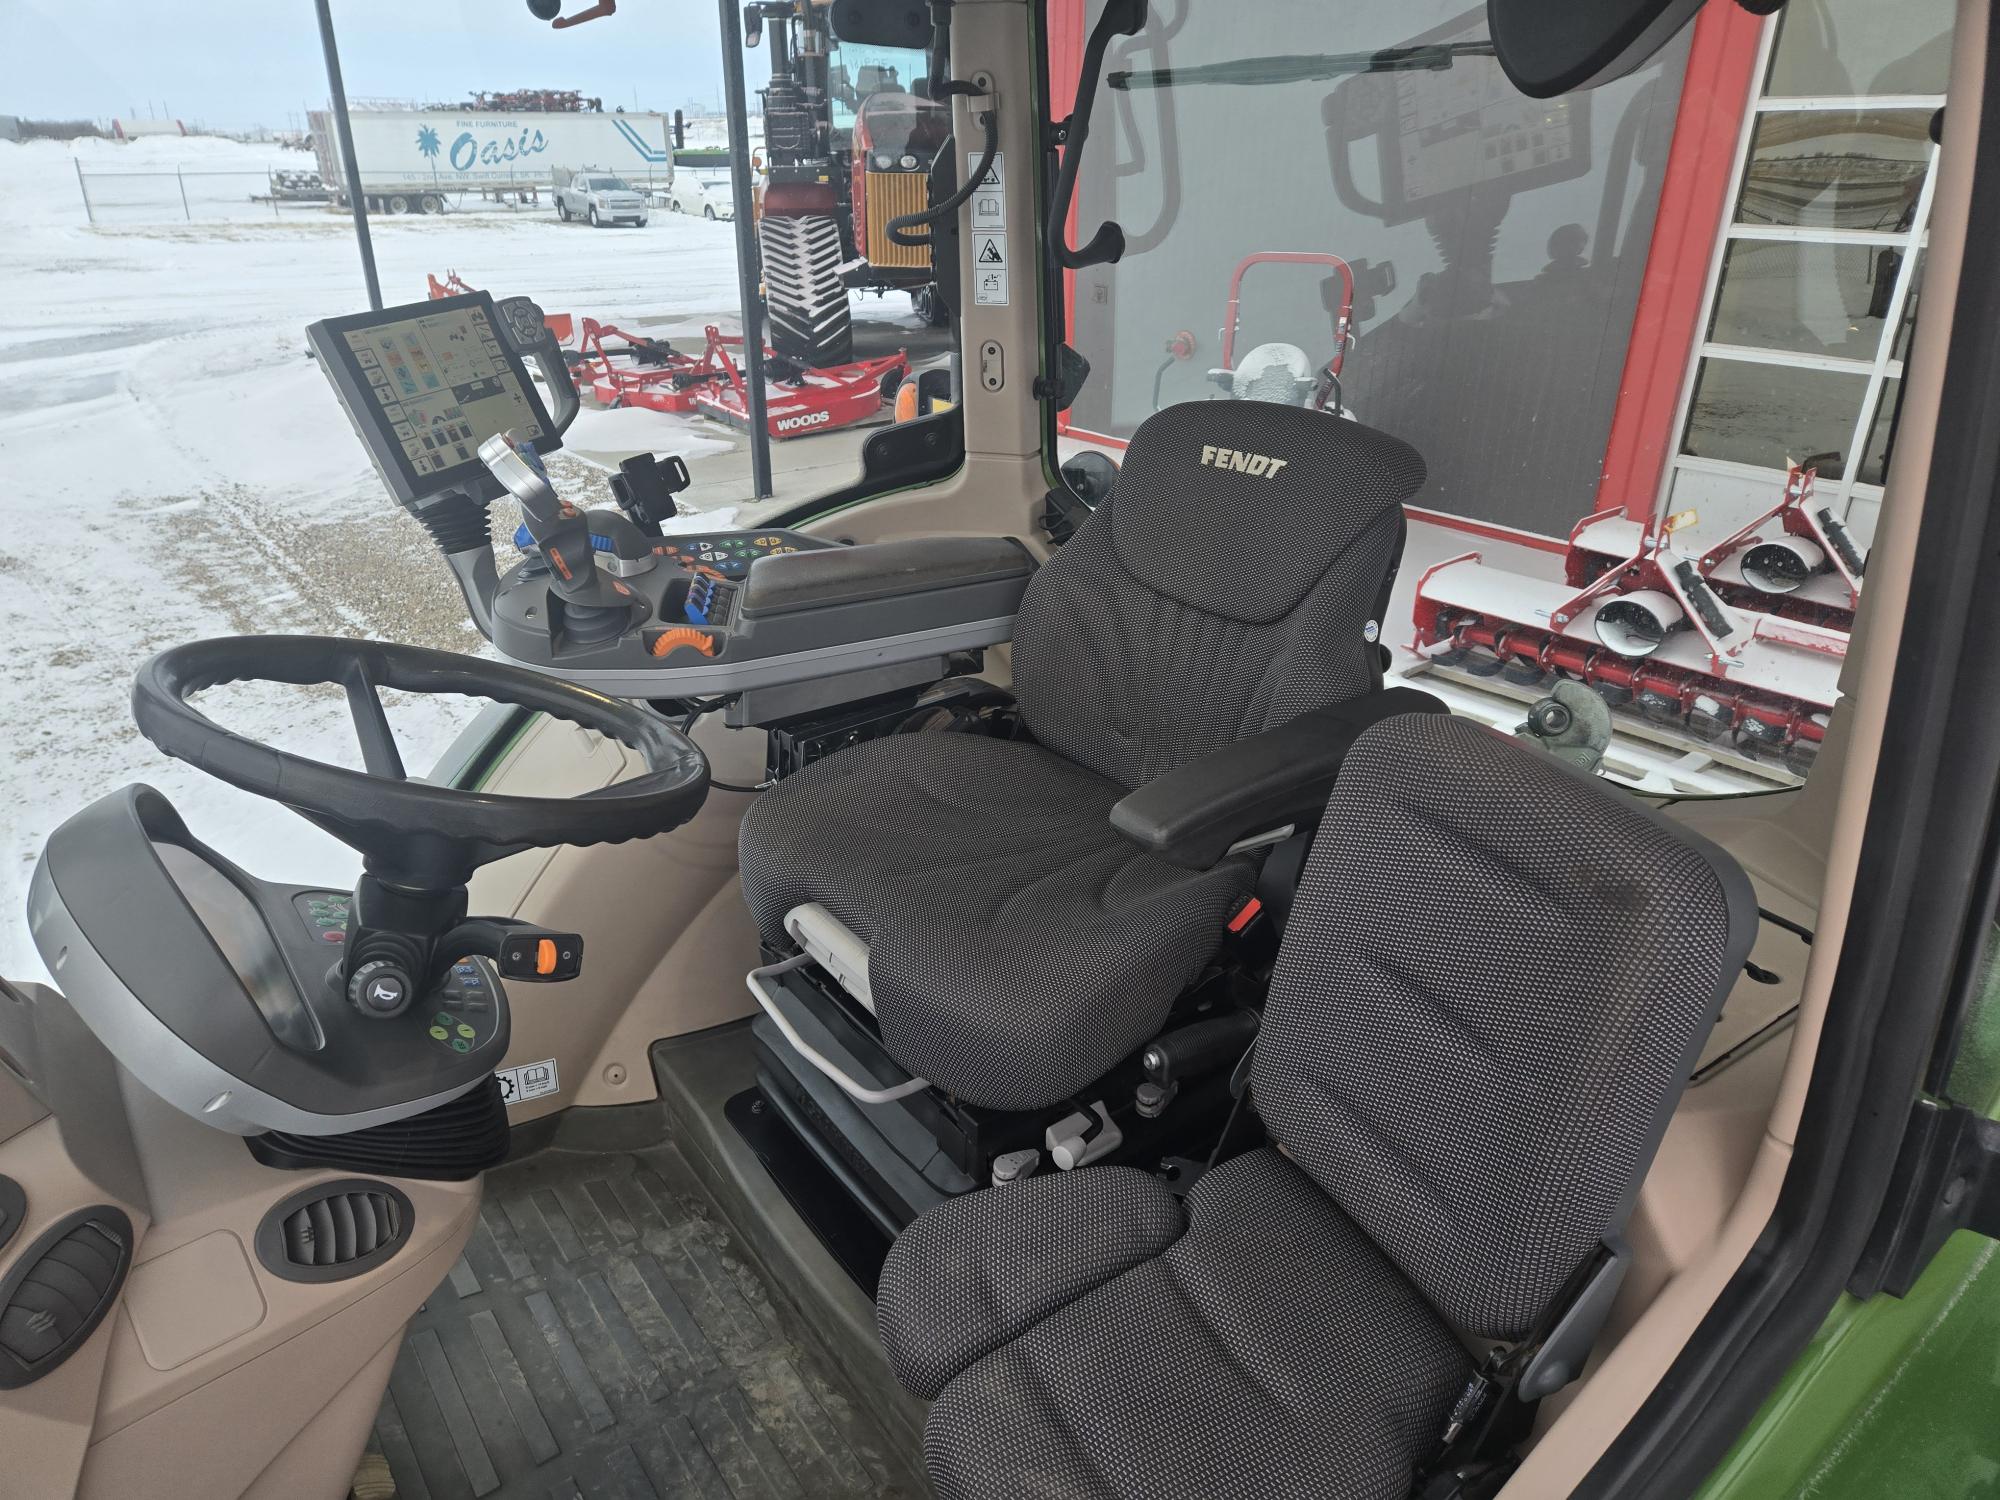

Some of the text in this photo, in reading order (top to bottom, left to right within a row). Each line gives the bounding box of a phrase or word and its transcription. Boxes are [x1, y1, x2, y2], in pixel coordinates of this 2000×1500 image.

[456, 120, 519, 128] FINE FURNITURE
[449, 127, 550, 171] Oasis
[776, 411, 830, 431] WOODS
[1200, 445, 1288, 479] FENDT
